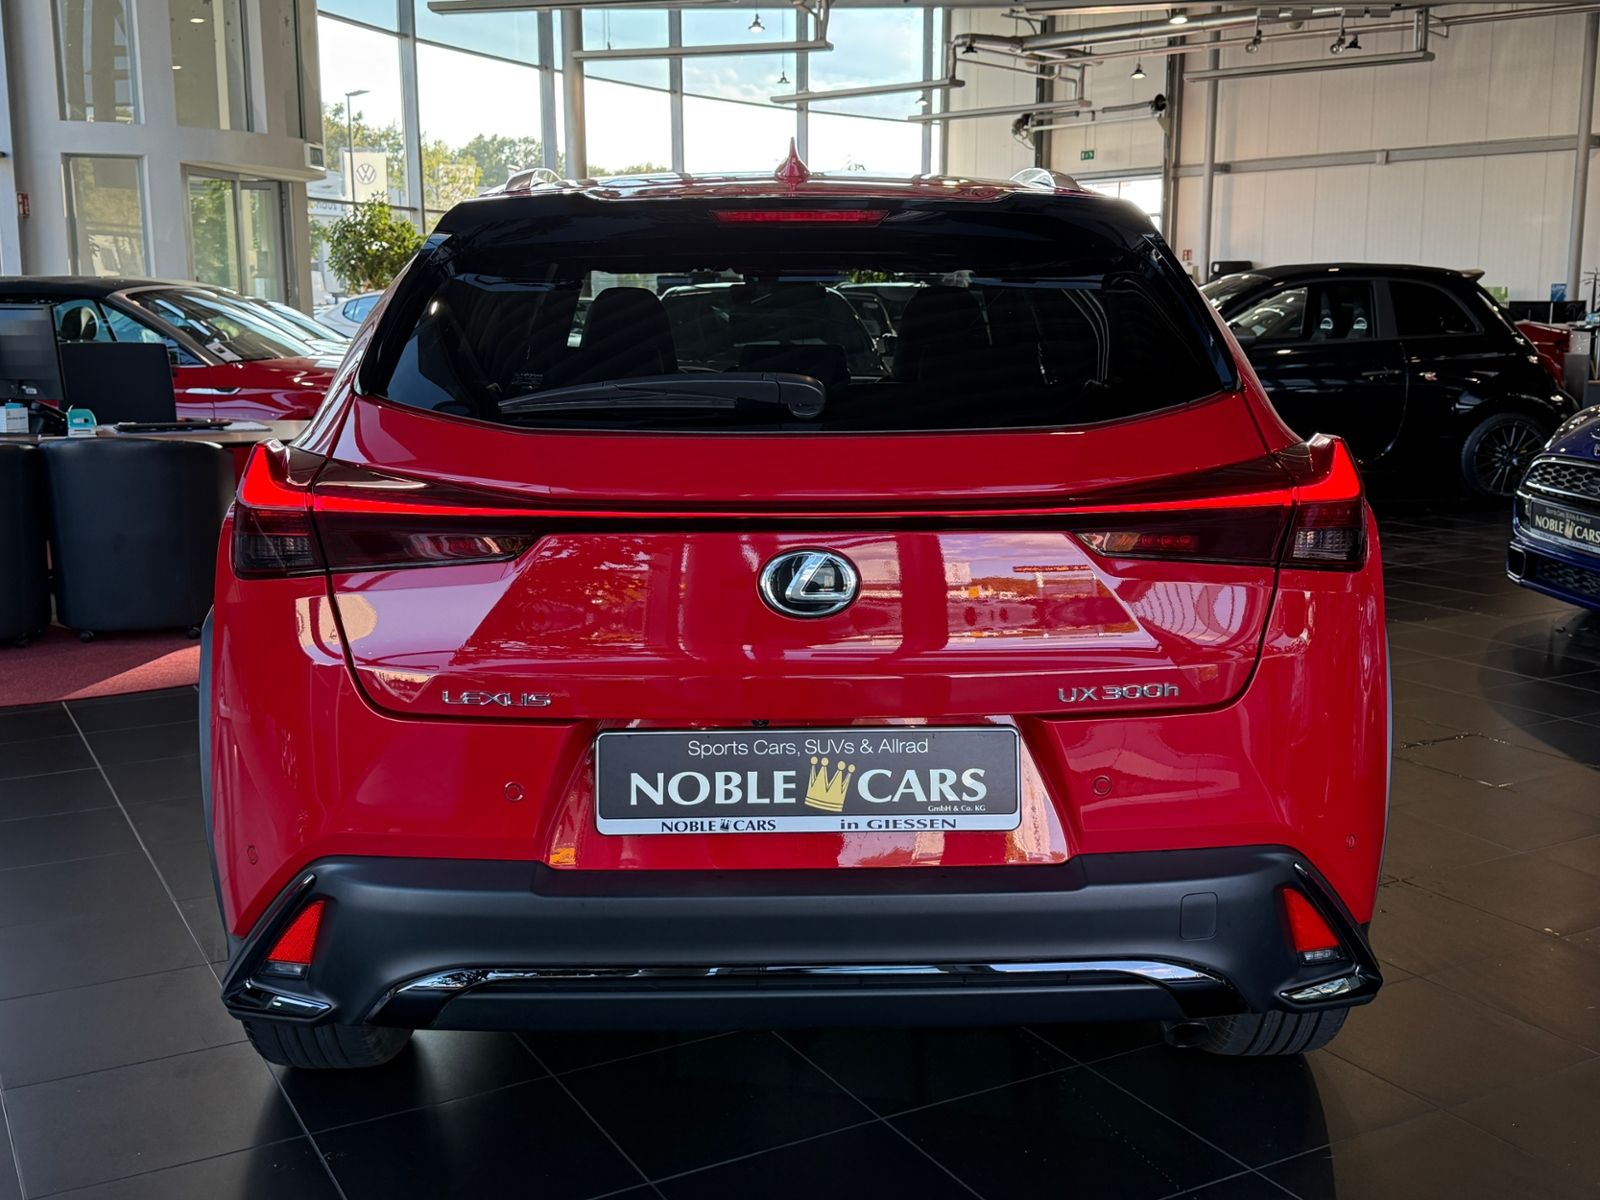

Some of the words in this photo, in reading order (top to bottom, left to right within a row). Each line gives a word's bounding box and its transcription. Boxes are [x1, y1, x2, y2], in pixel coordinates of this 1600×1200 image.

[1535, 514, 1565, 534] NOBLE
[1574, 525, 1600, 544] CARS
[442, 689, 552, 707] LEXUS
[1058, 686, 1098, 703] UX
[1101, 682, 1180, 701] 300h
[688, 740, 749, 759] Sports
[753, 739, 800, 757] Cars,
[804, 738, 855, 755] SUVs
[859, 738, 874, 754] &
[878, 738, 929, 754] Allrad
[630, 770, 797, 806] NOBLE
[857, 767, 987, 803] CARS
[961, 804, 973, 812] Co.
[975, 804, 986, 812] KG
[661, 820, 716, 832] NOBLE
[733, 820, 777, 832] CARS
[840, 820, 859, 830] in
[867, 819, 957, 830] GIESSEN
